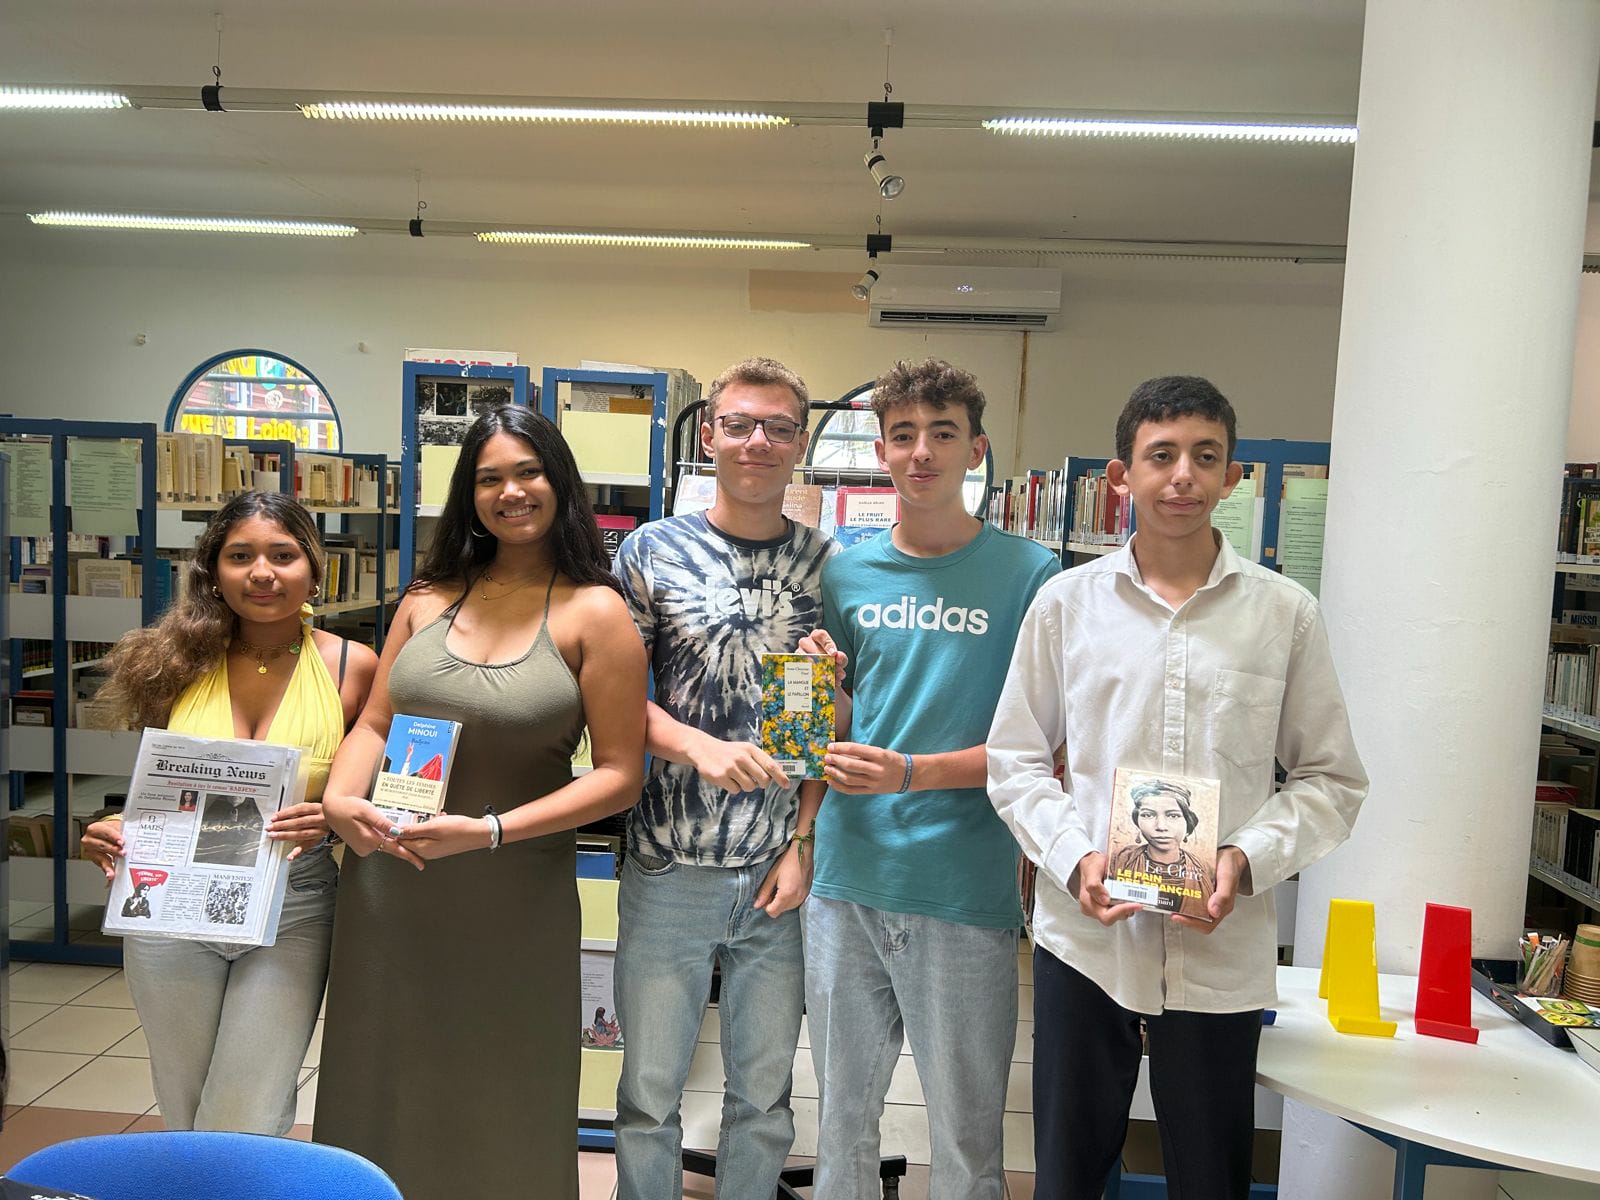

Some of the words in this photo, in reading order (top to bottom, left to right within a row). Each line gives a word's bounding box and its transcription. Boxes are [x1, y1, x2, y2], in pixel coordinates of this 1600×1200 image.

[857, 596, 989, 635] adidas
[407, 727, 438, 738] MINOUI
[156, 759, 222, 778] Breaking
[226, 765, 266, 780] News
[1117, 868, 1132, 878] LE
[1134, 871, 1162, 884] PAIN
[1145, 860, 1163, 874] Le
[1167, 864, 1203, 881] Clerc
